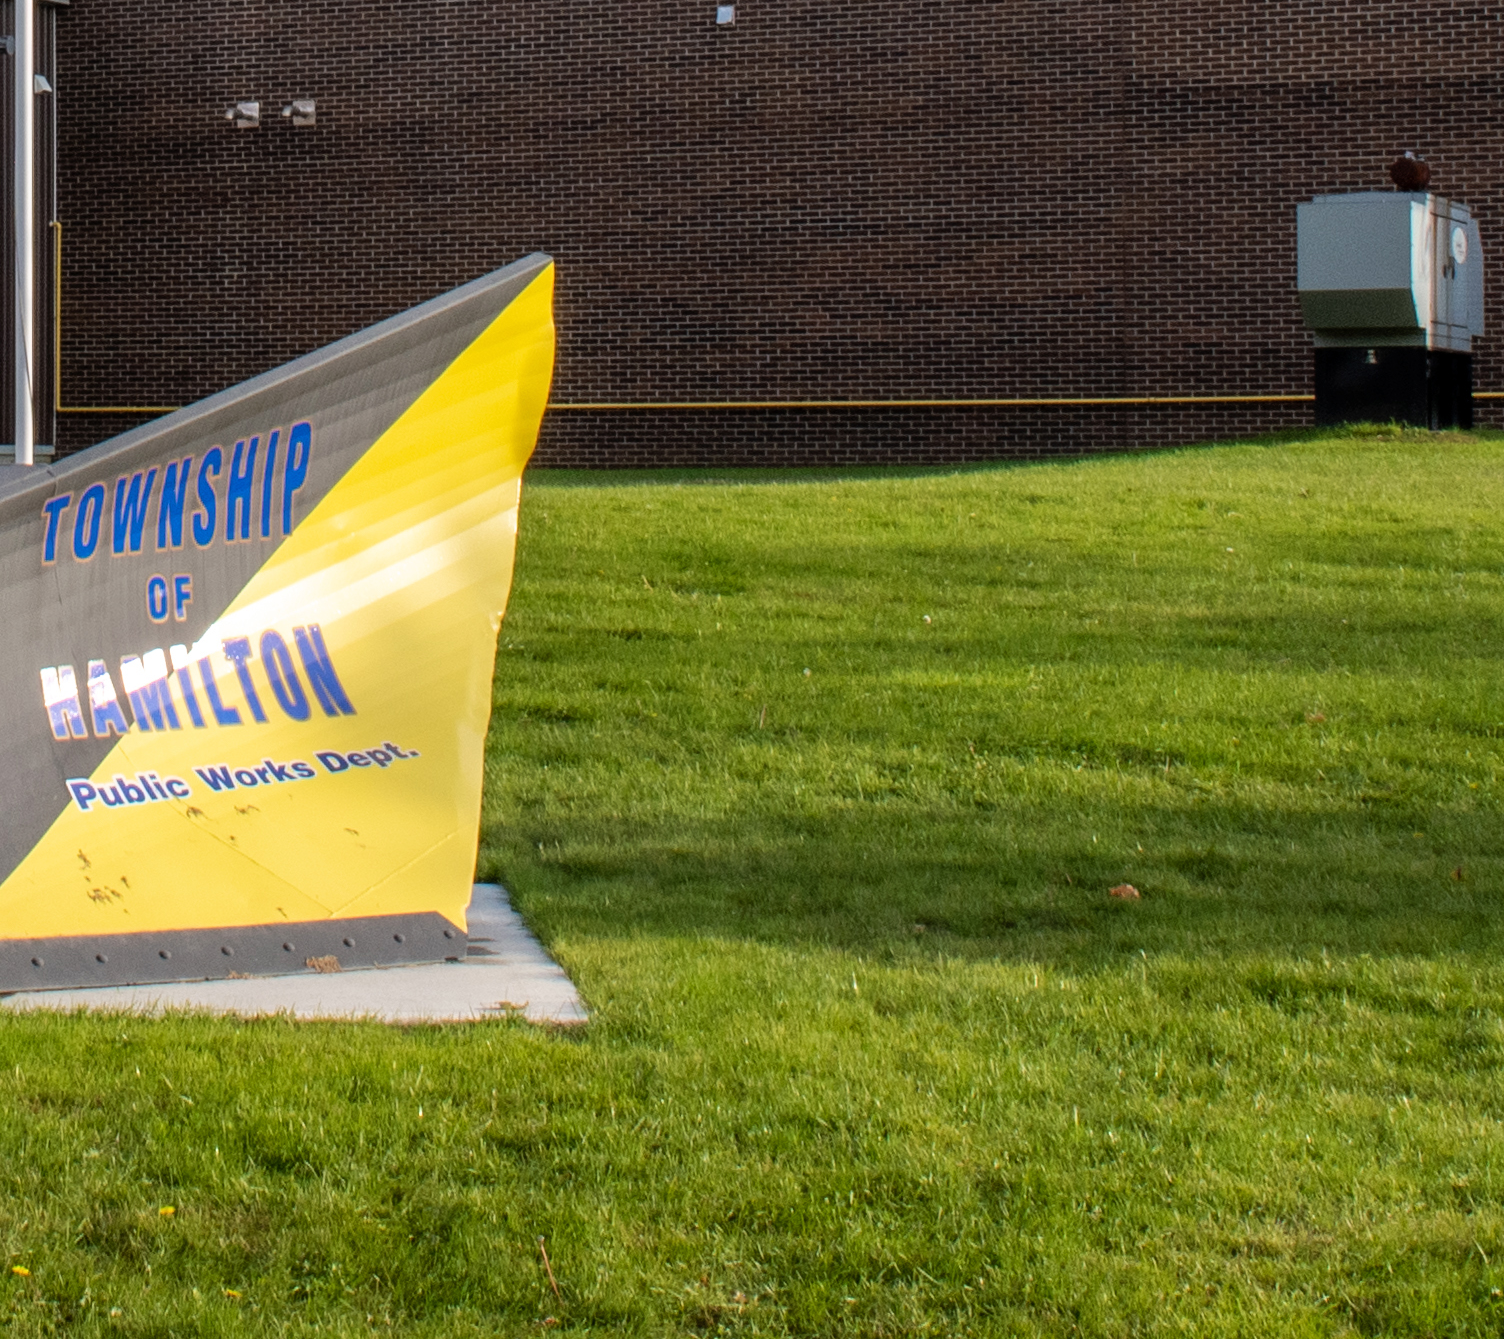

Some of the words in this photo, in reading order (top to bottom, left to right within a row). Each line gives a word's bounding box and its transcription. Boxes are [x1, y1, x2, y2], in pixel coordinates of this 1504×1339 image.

[42, 421, 312, 565] TOWNSHIP
[146, 574, 193, 623] OF
[40, 624, 357, 741] HAMILTON
[68, 773, 191, 811] Public
[194, 759, 316, 793] Works
[315, 741, 420, 775] Dept.
